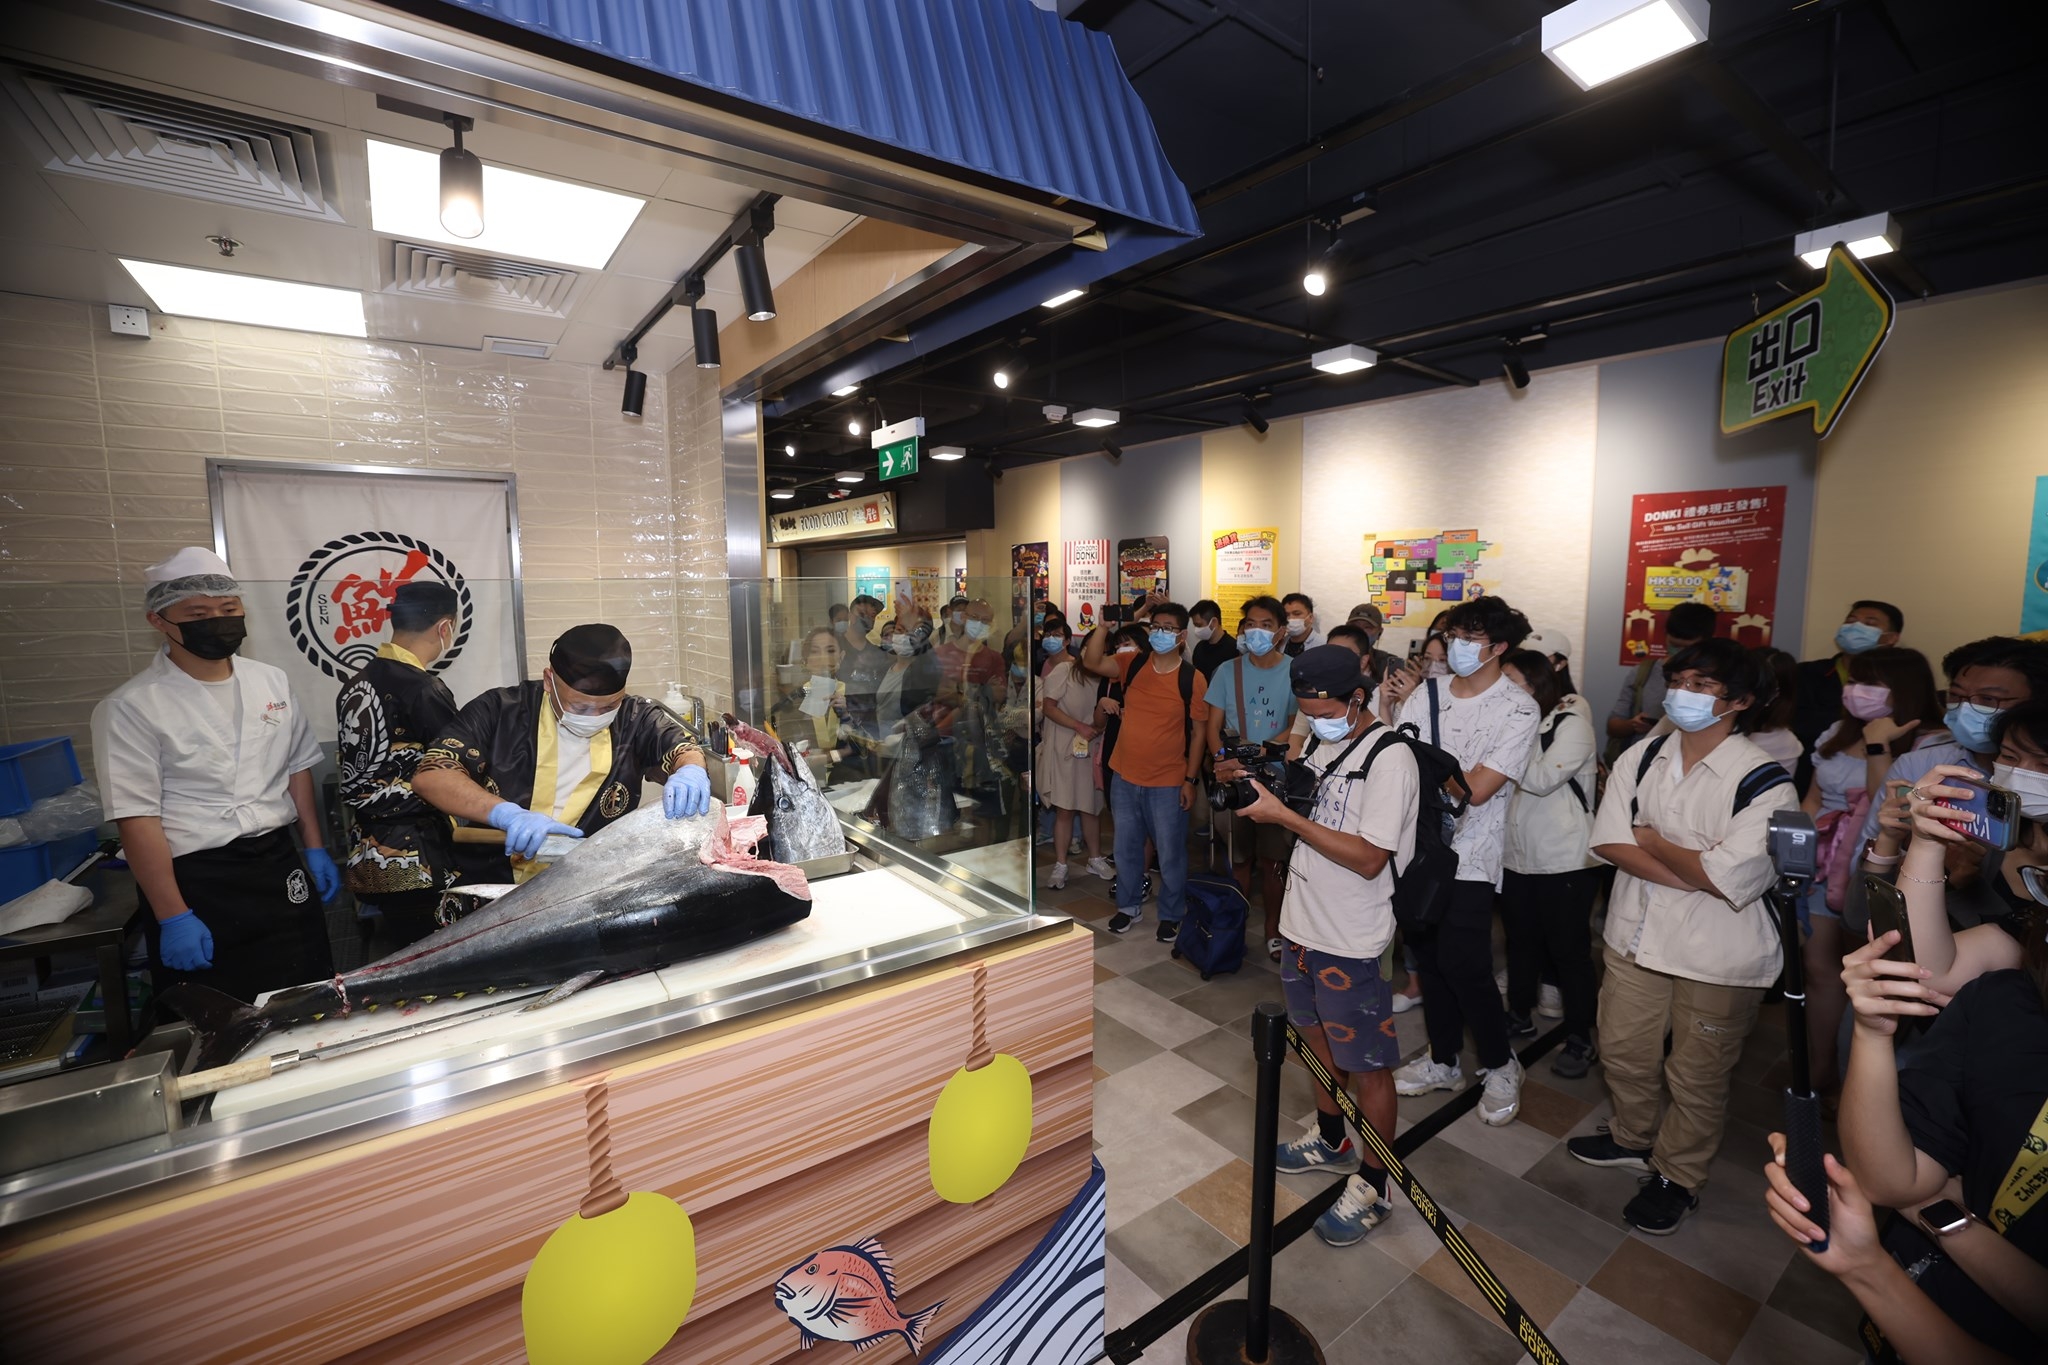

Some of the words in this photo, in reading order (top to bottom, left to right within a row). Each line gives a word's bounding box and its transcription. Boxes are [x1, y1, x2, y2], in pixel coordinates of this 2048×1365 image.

[1748, 299, 1821, 382] 出口
[1753, 361, 1807, 416] Exit
[800, 514, 820, 531] FOOD
[821, 508, 848, 528] COURT
[1644, 509, 1682, 522] DONKI
[1692, 519, 1706, 529] Gift
[1076, 551, 1098, 560] DONKI
[1245, 562, 1251, 572] 7
[317, 594, 329, 625] SEN
[361, 728, 369, 751] SEN
[1303, 1150, 1325, 1165] N
[1360, 1213, 1379, 1230] N
